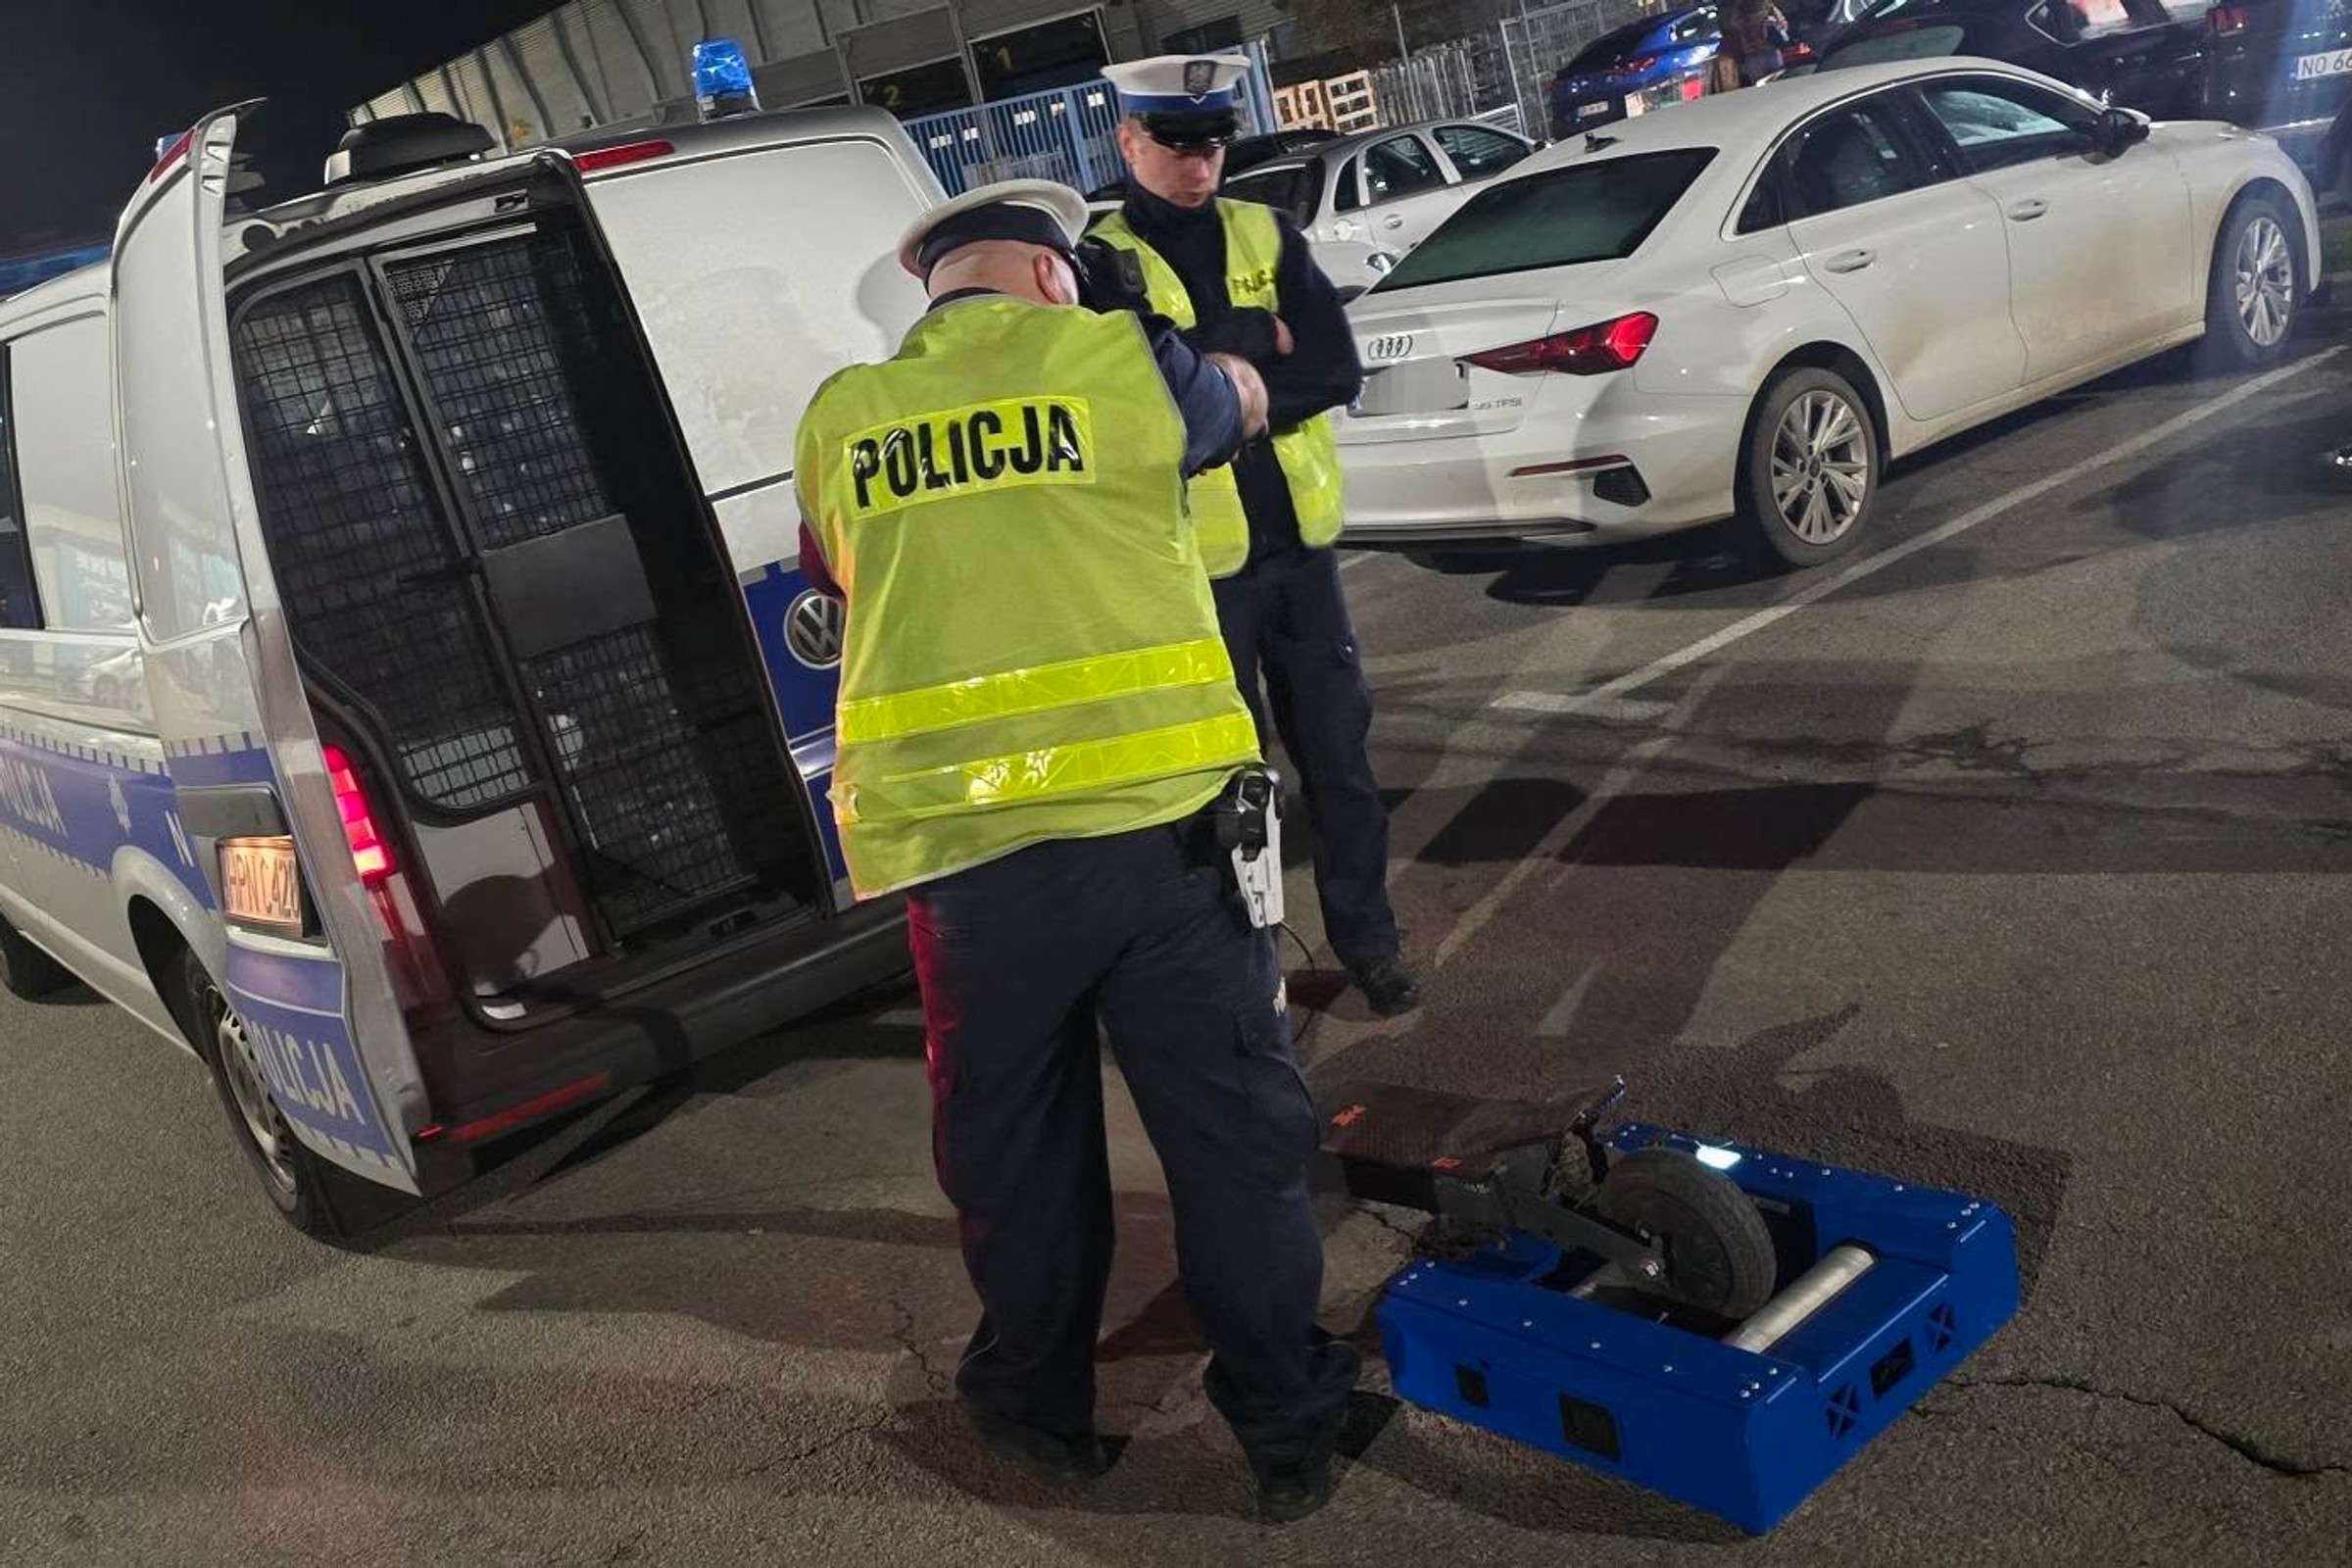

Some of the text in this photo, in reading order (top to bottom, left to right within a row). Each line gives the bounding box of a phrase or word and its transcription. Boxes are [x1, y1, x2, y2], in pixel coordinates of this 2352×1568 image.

[997, 47, 1012, 70] 1
[2301, 56, 2327, 77] NO
[884, 84, 902, 107] 2
[852, 404, 1084, 509] POLICJA
